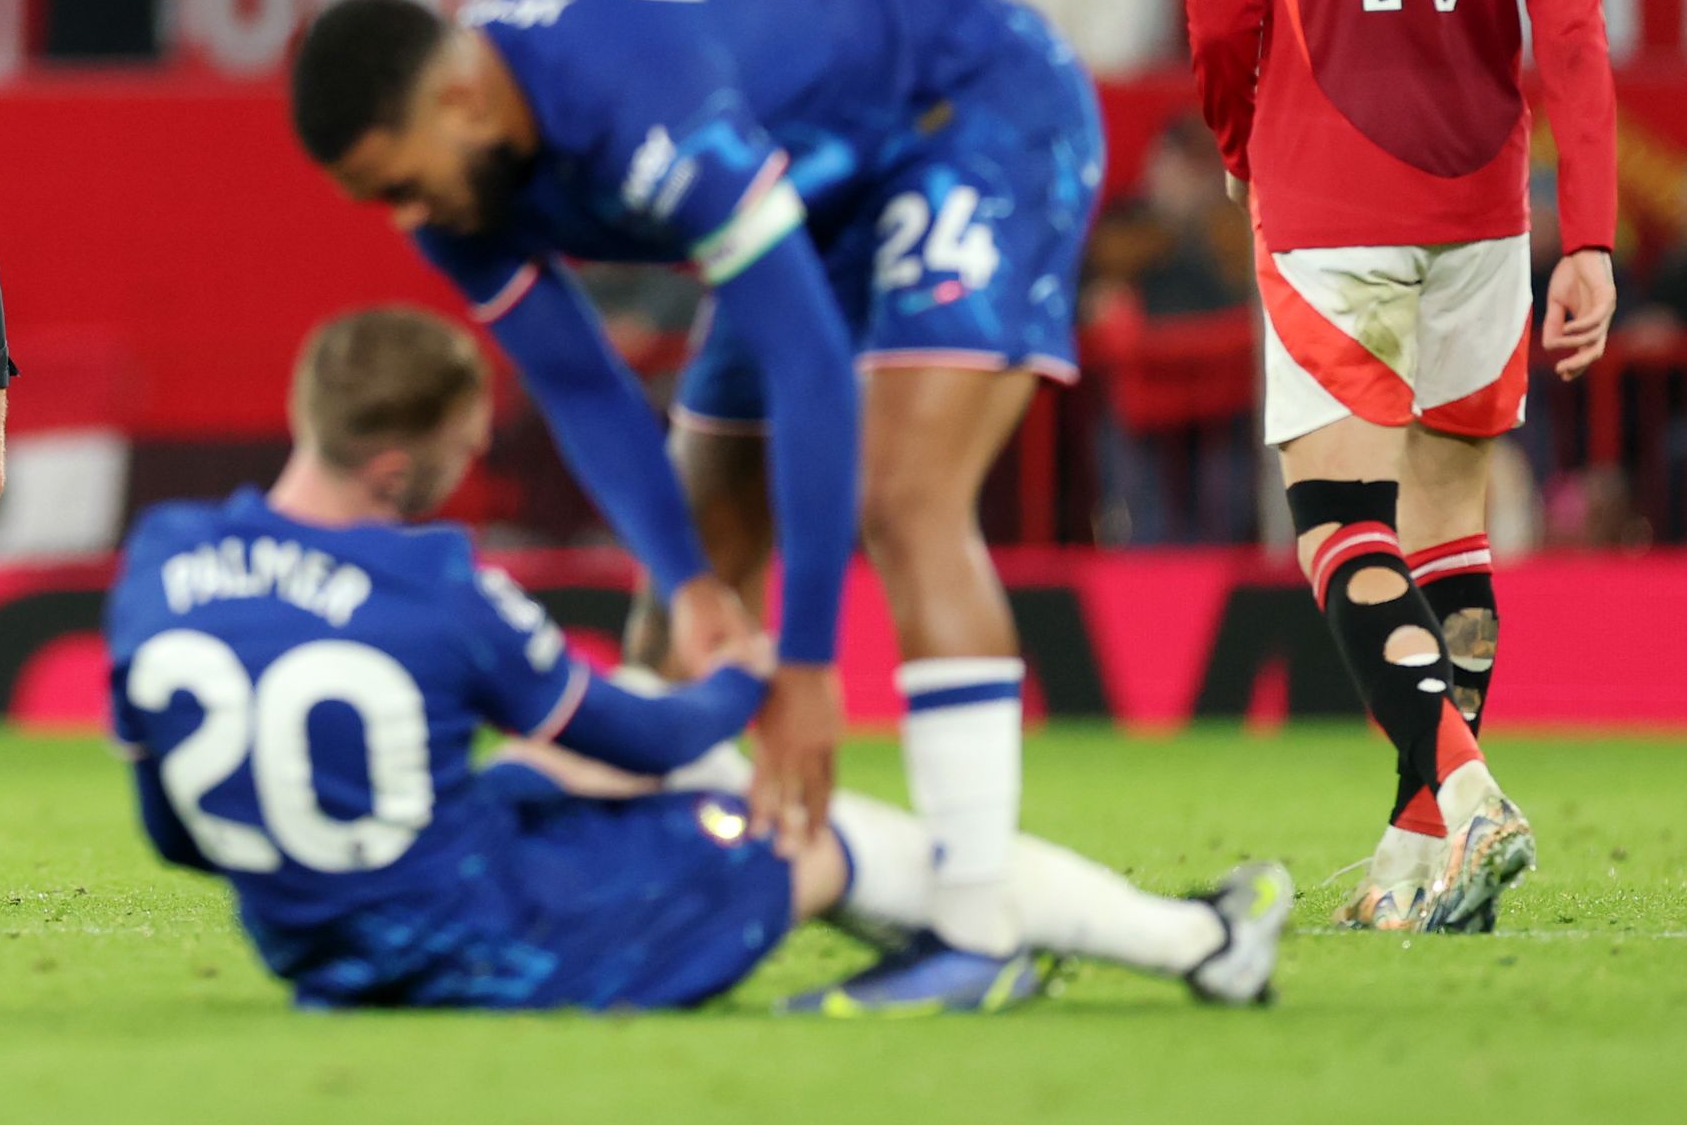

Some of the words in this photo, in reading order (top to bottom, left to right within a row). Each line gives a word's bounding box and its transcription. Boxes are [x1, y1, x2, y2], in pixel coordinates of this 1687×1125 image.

[873, 185, 1000, 292] 24
[162, 536, 372, 627] PALMER
[127, 628, 436, 874] 20
